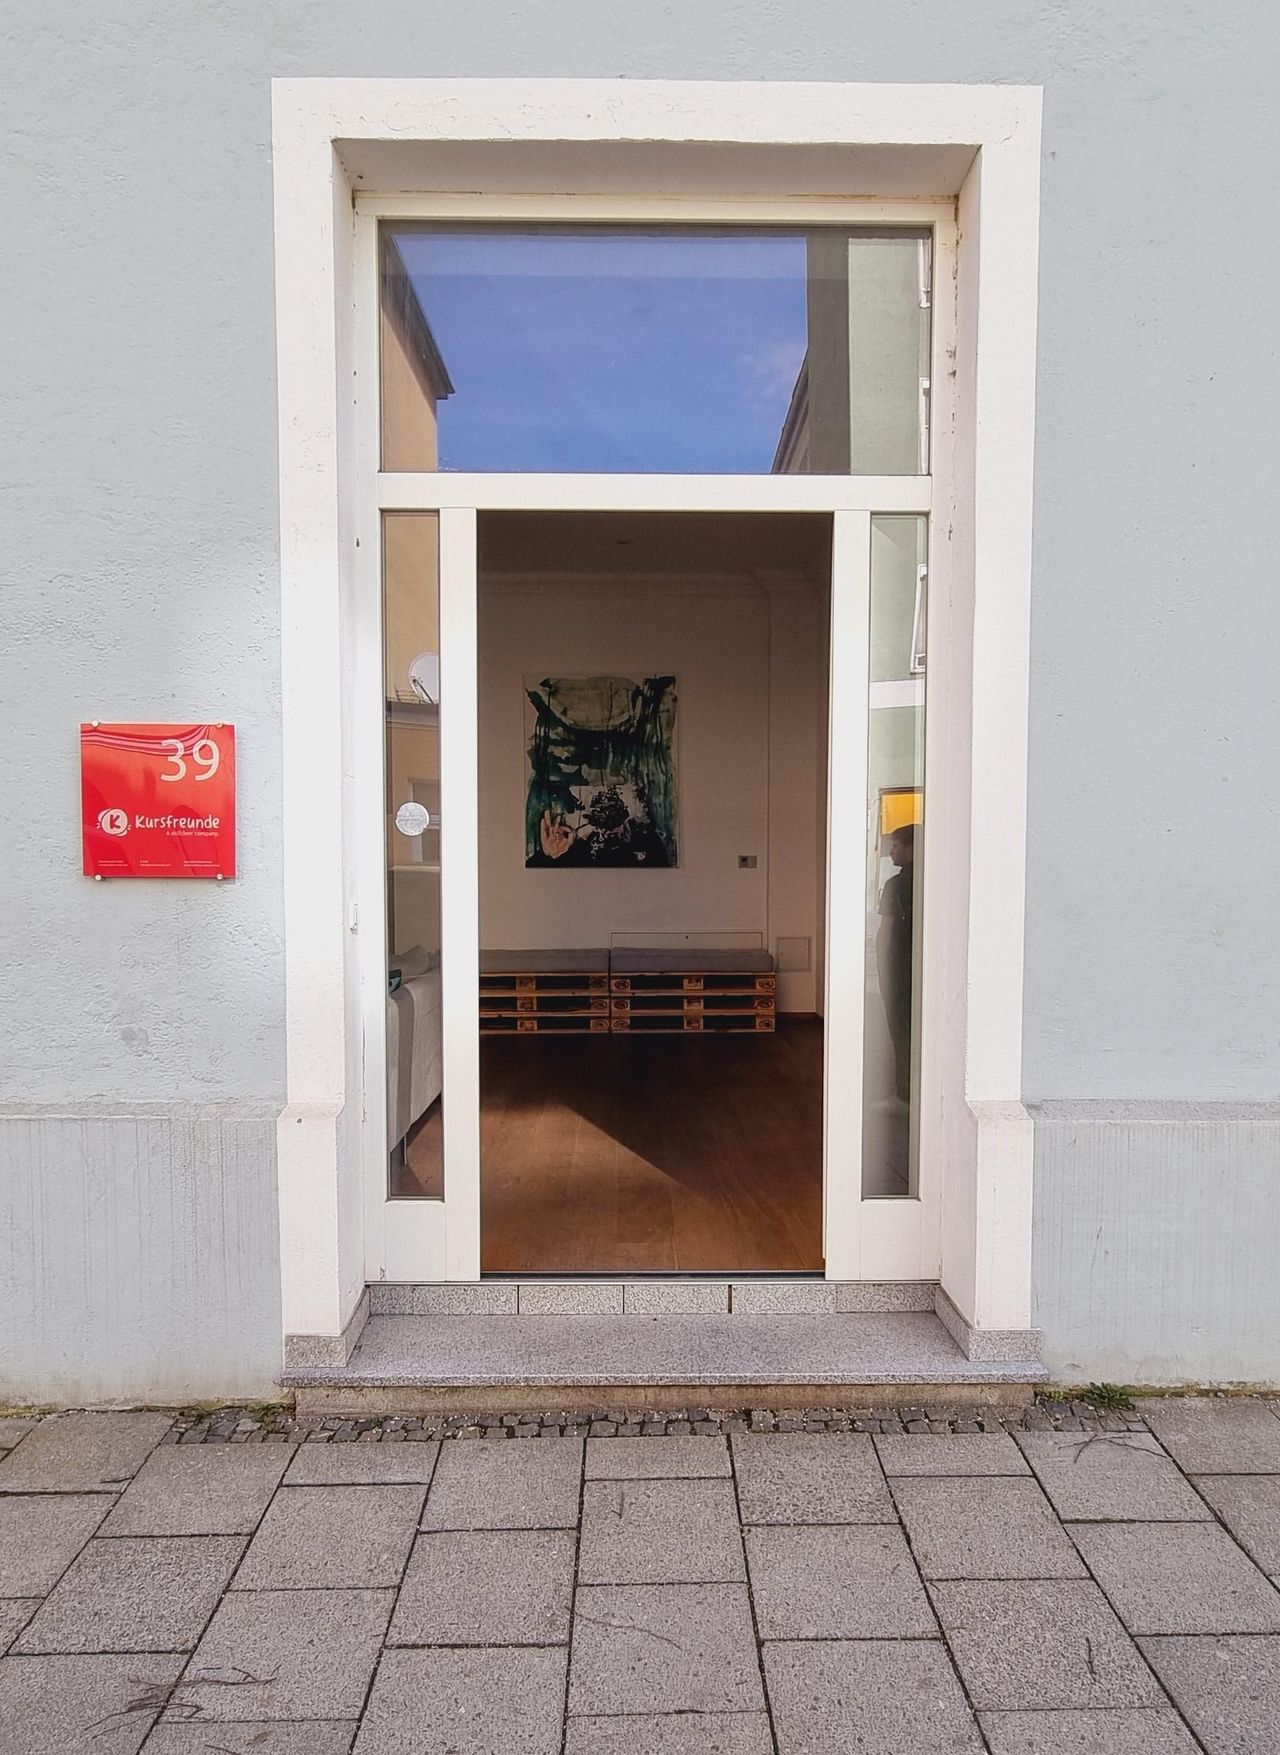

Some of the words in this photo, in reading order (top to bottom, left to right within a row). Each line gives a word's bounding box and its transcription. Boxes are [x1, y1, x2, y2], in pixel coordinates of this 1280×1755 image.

[160, 739, 220, 782] 39
[109, 814, 121, 829] K
[135, 814, 220, 829] Kursfreunde
